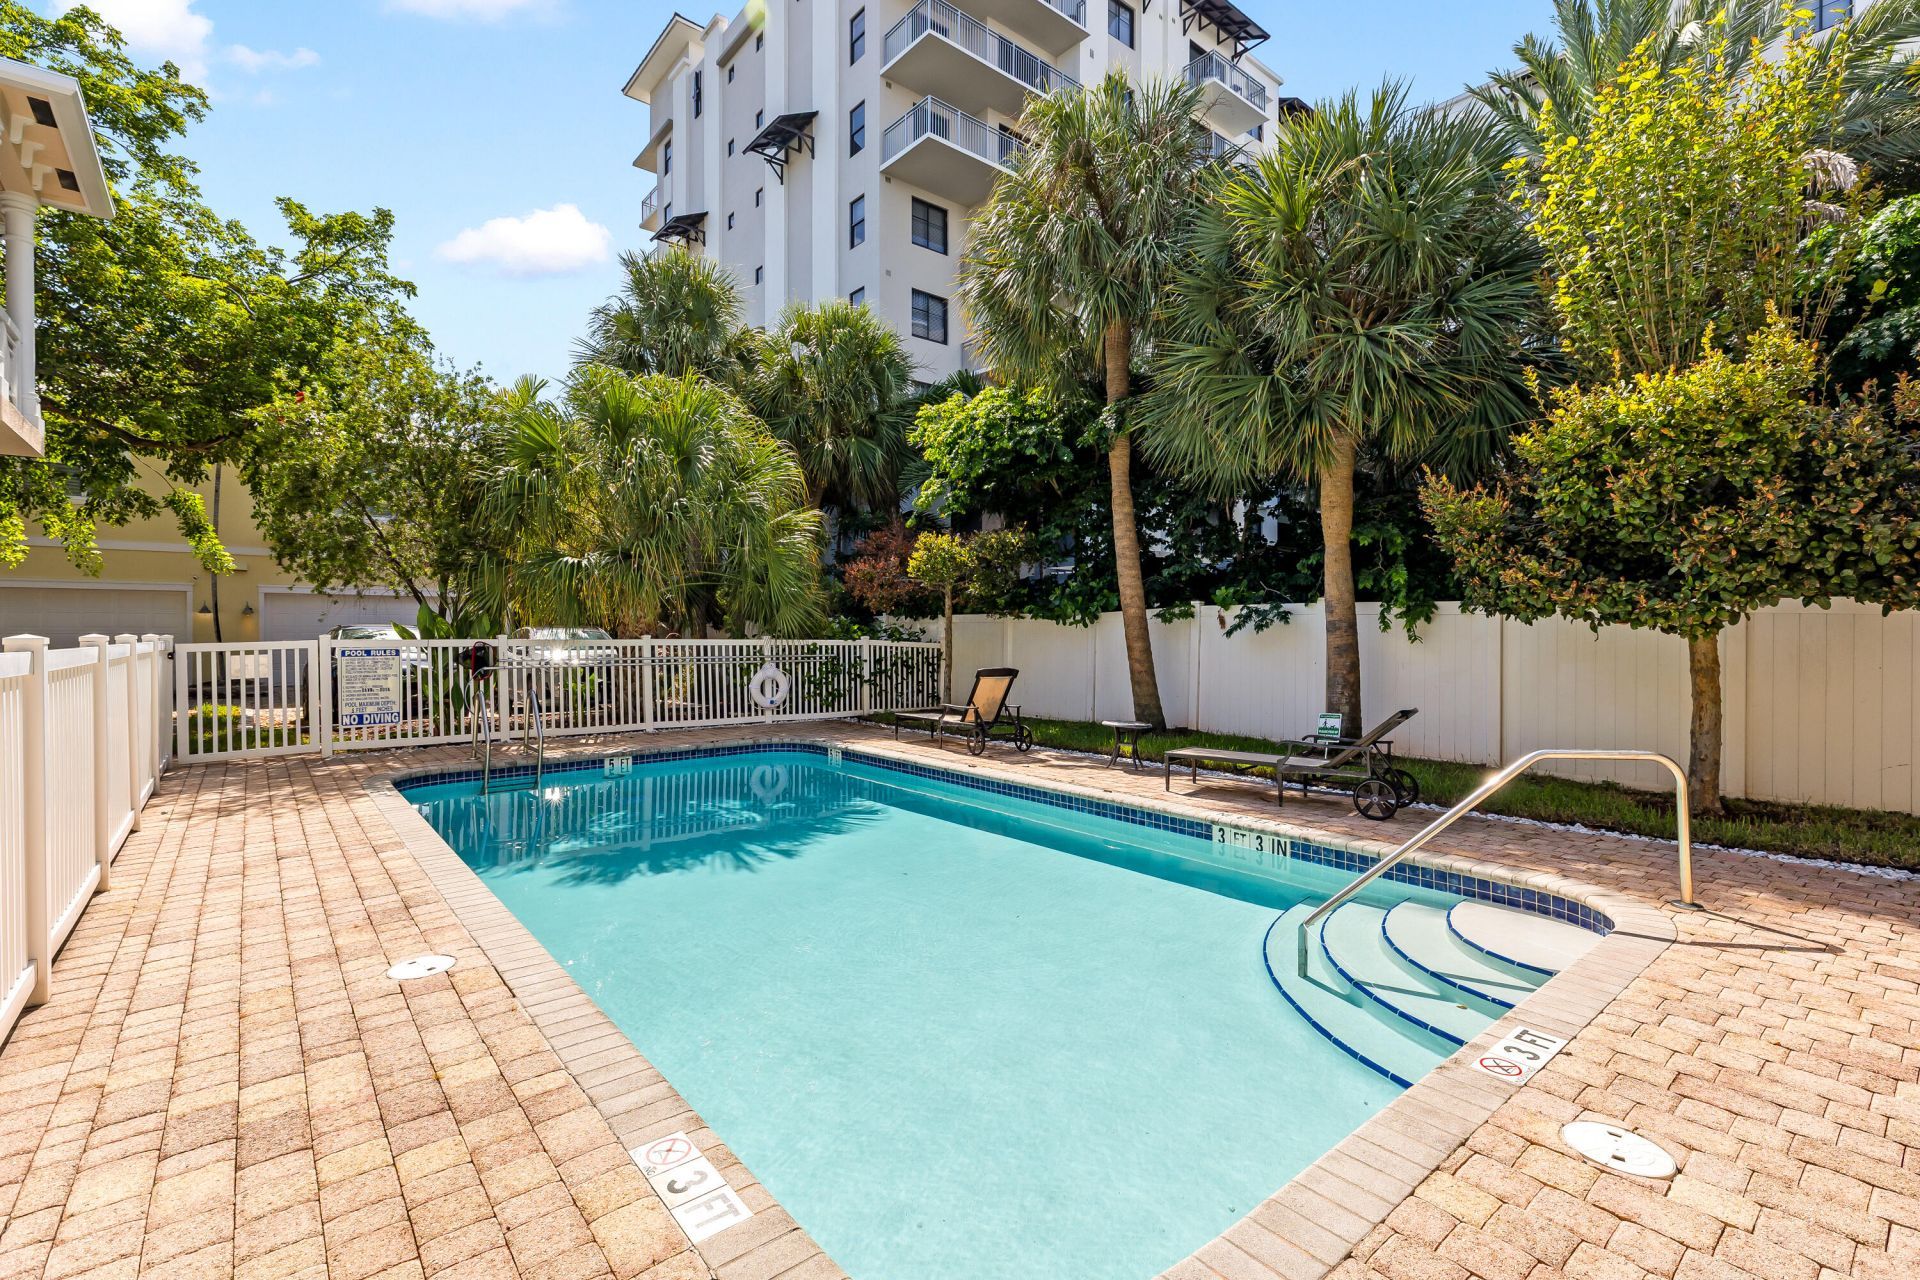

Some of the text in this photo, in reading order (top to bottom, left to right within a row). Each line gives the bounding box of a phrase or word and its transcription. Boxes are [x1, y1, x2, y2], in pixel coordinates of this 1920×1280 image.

[343, 713, 398, 725] NO DIVING
[609, 759, 614, 768] 5
[1218, 828, 1287, 857] 3 FT 3 IN
[1504, 1029, 1557, 1060] 3 FT
[667, 1170, 740, 1229] 3 FT
